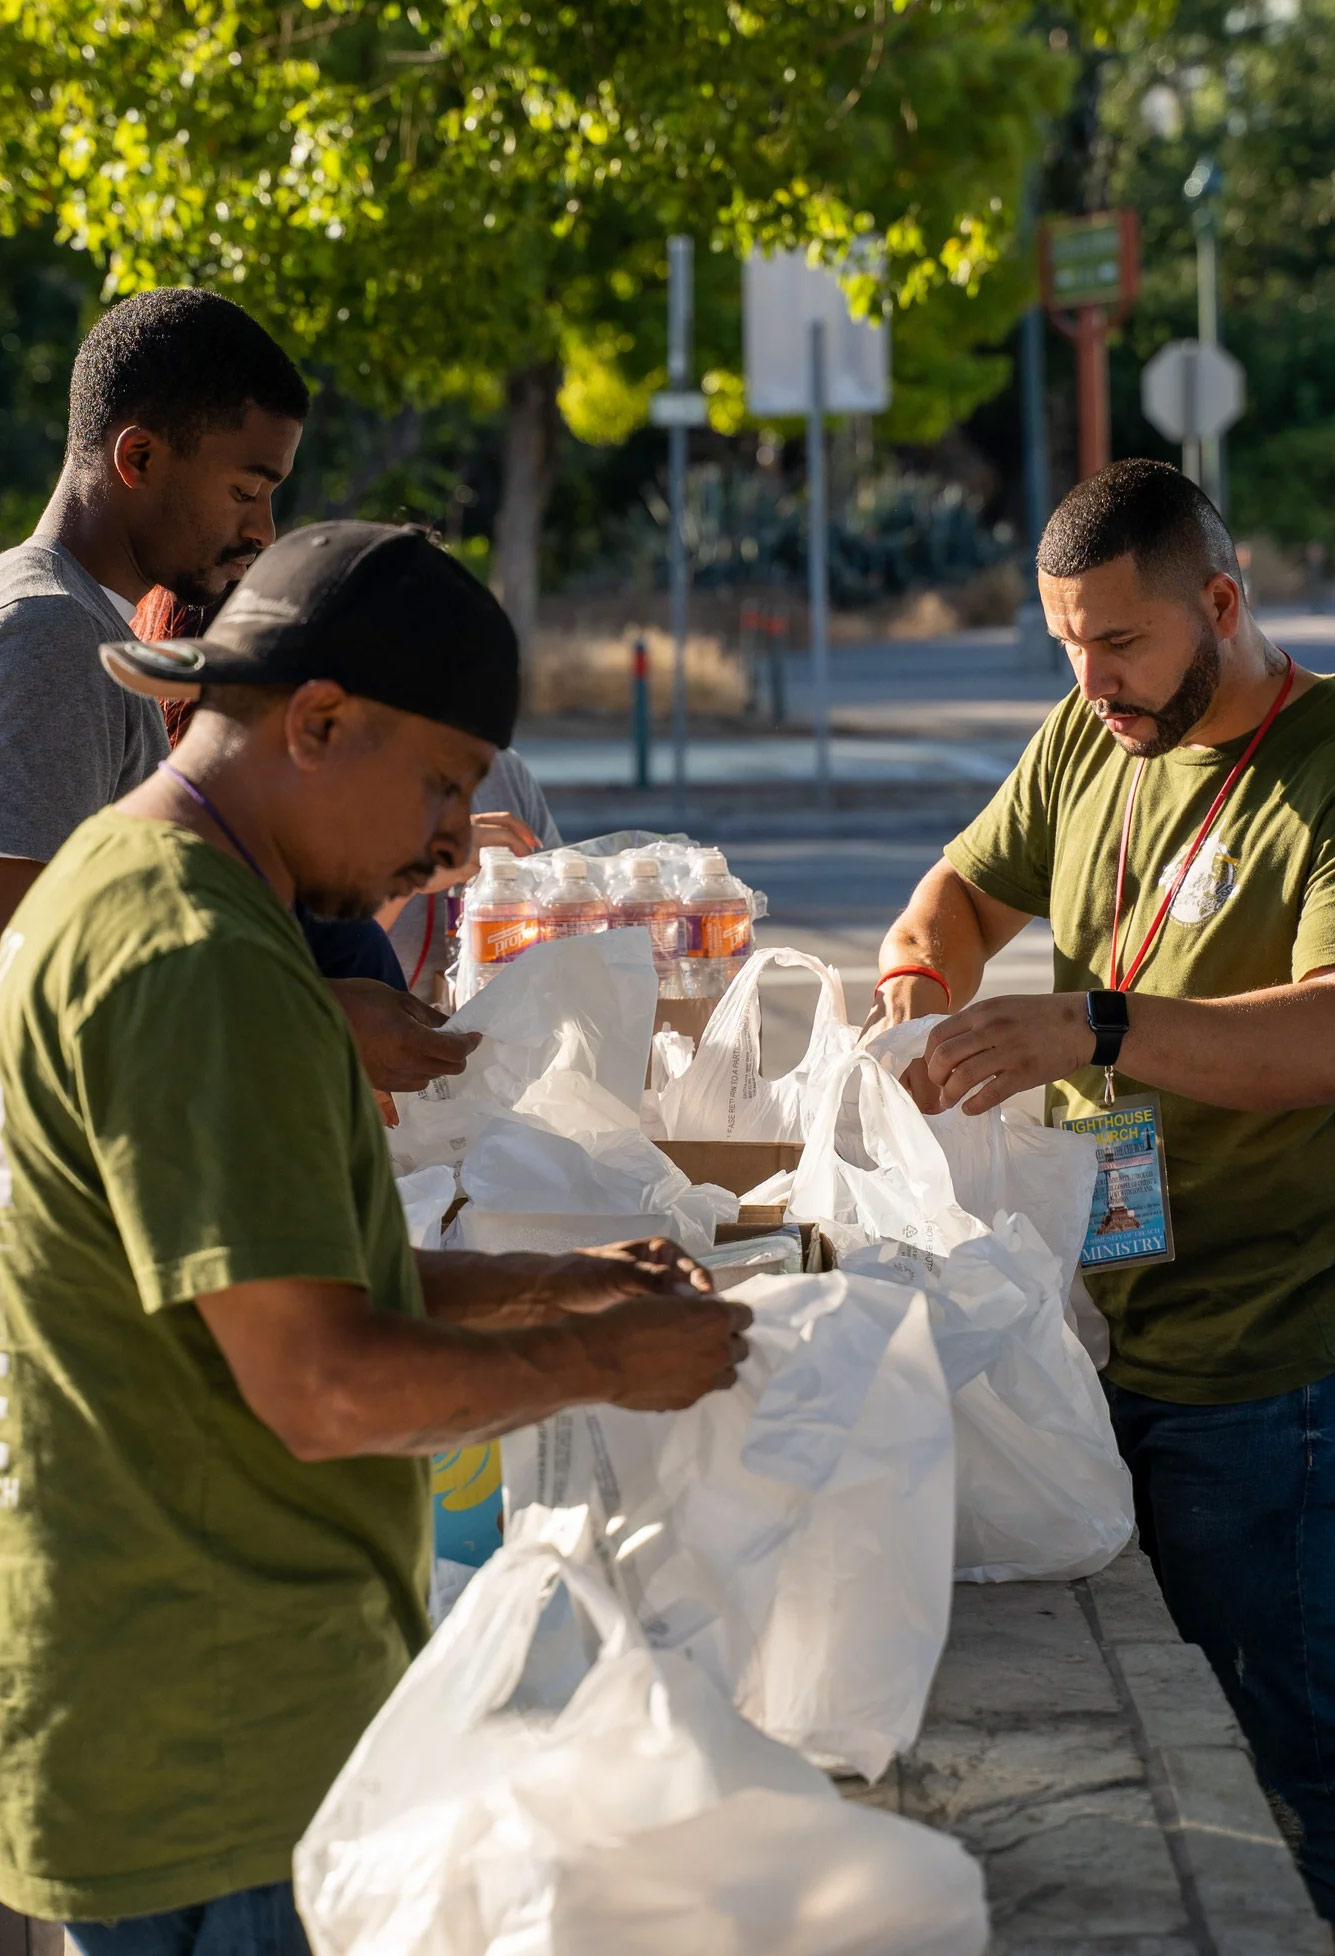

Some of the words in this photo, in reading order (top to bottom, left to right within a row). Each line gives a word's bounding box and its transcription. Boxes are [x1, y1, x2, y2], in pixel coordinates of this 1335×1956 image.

[731, 1075, 738, 1086] TO
[1096, 1127, 1138, 1145] URCH
[1082, 1234, 1163, 1261] MINISTRY
